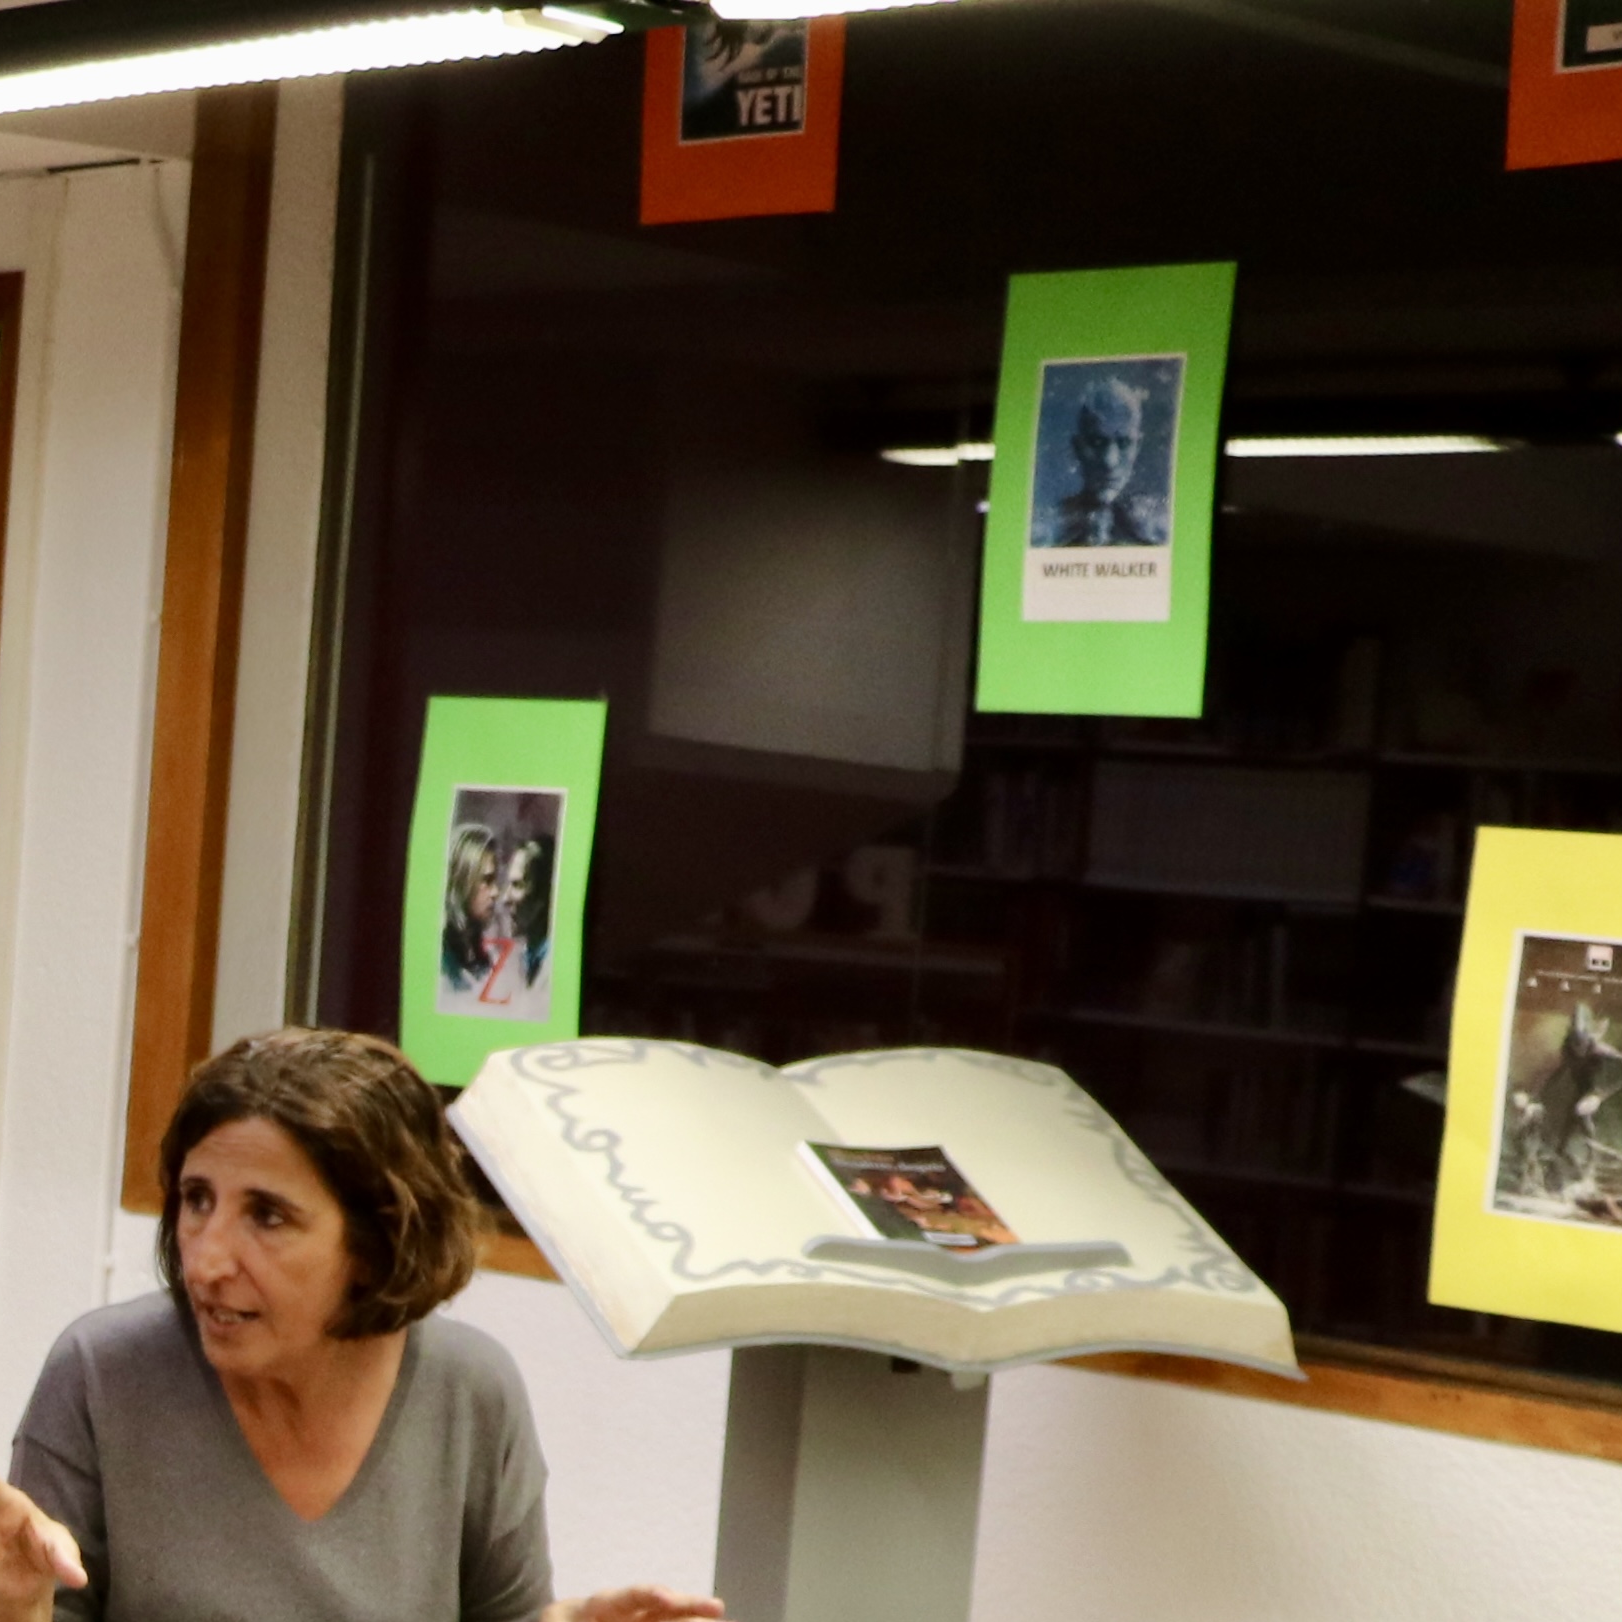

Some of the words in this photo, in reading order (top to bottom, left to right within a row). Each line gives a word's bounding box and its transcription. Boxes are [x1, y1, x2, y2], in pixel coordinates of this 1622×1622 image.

[737, 84, 803, 126] YETI
[1042, 562, 1089, 578] WHITE
[1095, 562, 1158, 578] WALKER
[478, 936, 515, 1005] Z
